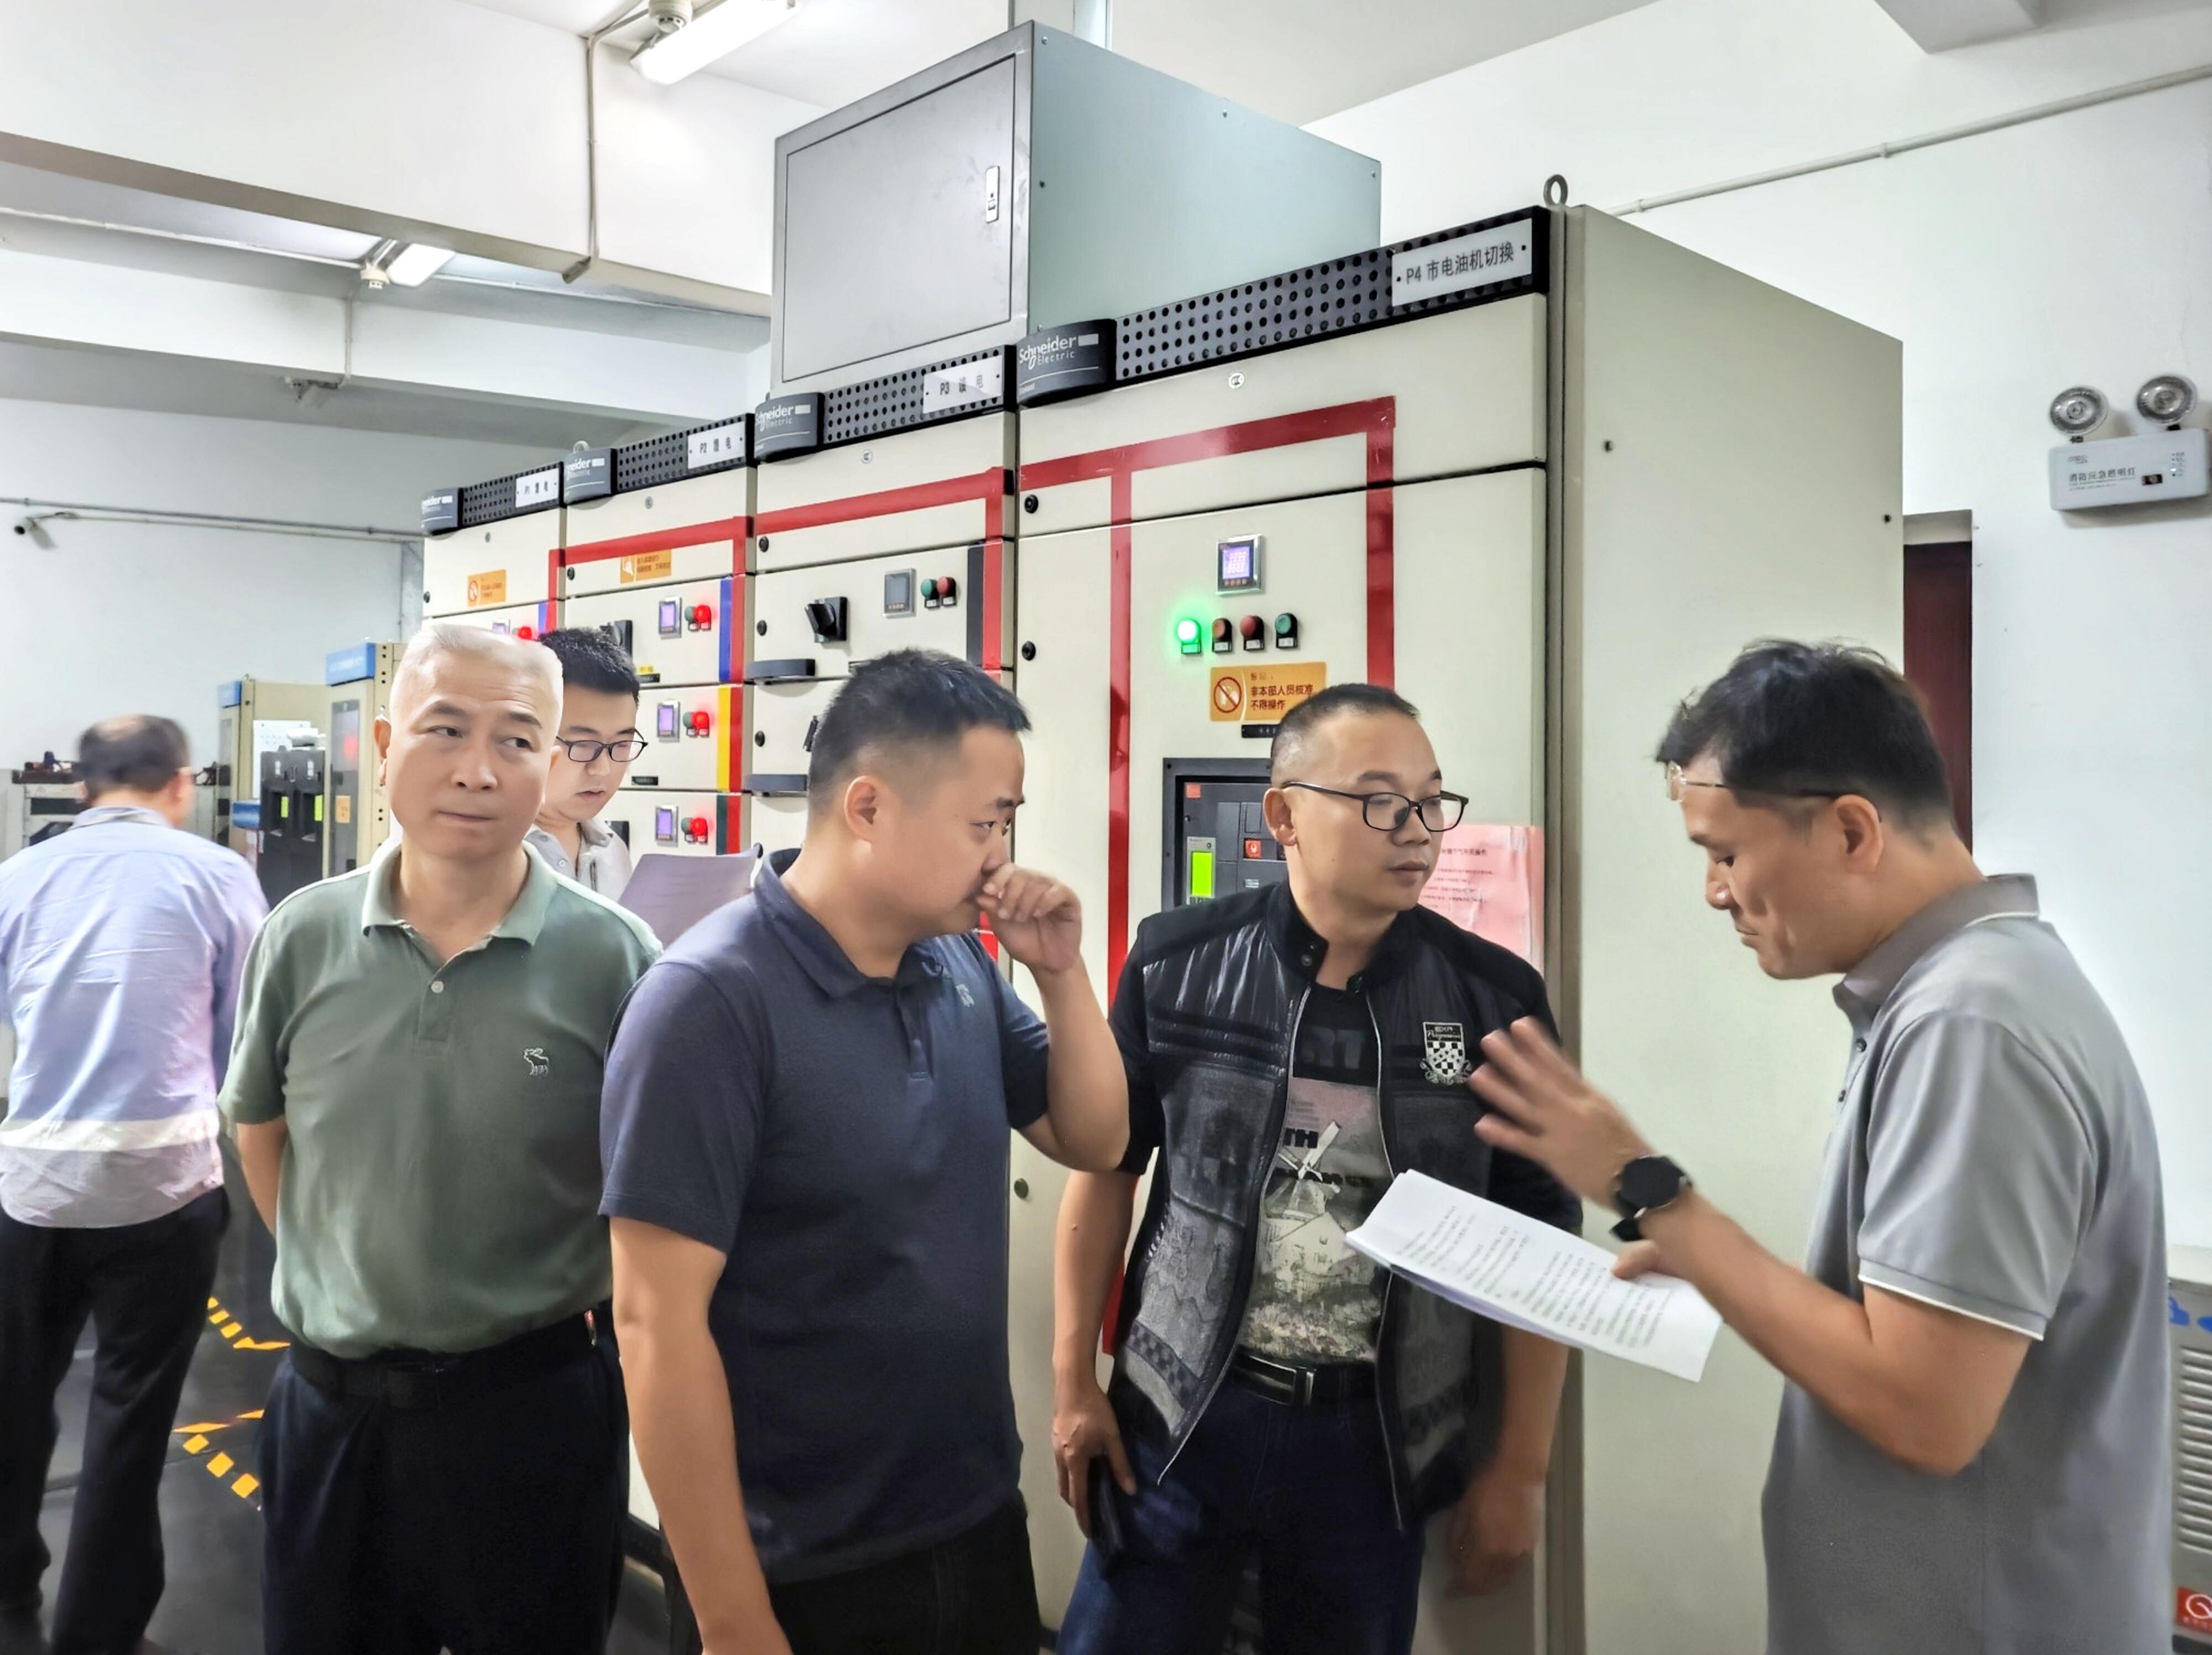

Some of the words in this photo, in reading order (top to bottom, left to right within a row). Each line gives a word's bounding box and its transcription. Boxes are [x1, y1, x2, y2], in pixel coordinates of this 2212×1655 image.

[1406, 266, 1421, 284] P4
[1427, 241, 1514, 281] 市电油机切换
[1019, 335, 1076, 369] Schneider
[1037, 351, 1075, 365] Electric
[940, 382, 950, 395] P3
[2069, 468, 2135, 482] 消防应急照明灯
[1251, 700, 1286, 711] 不得操作
